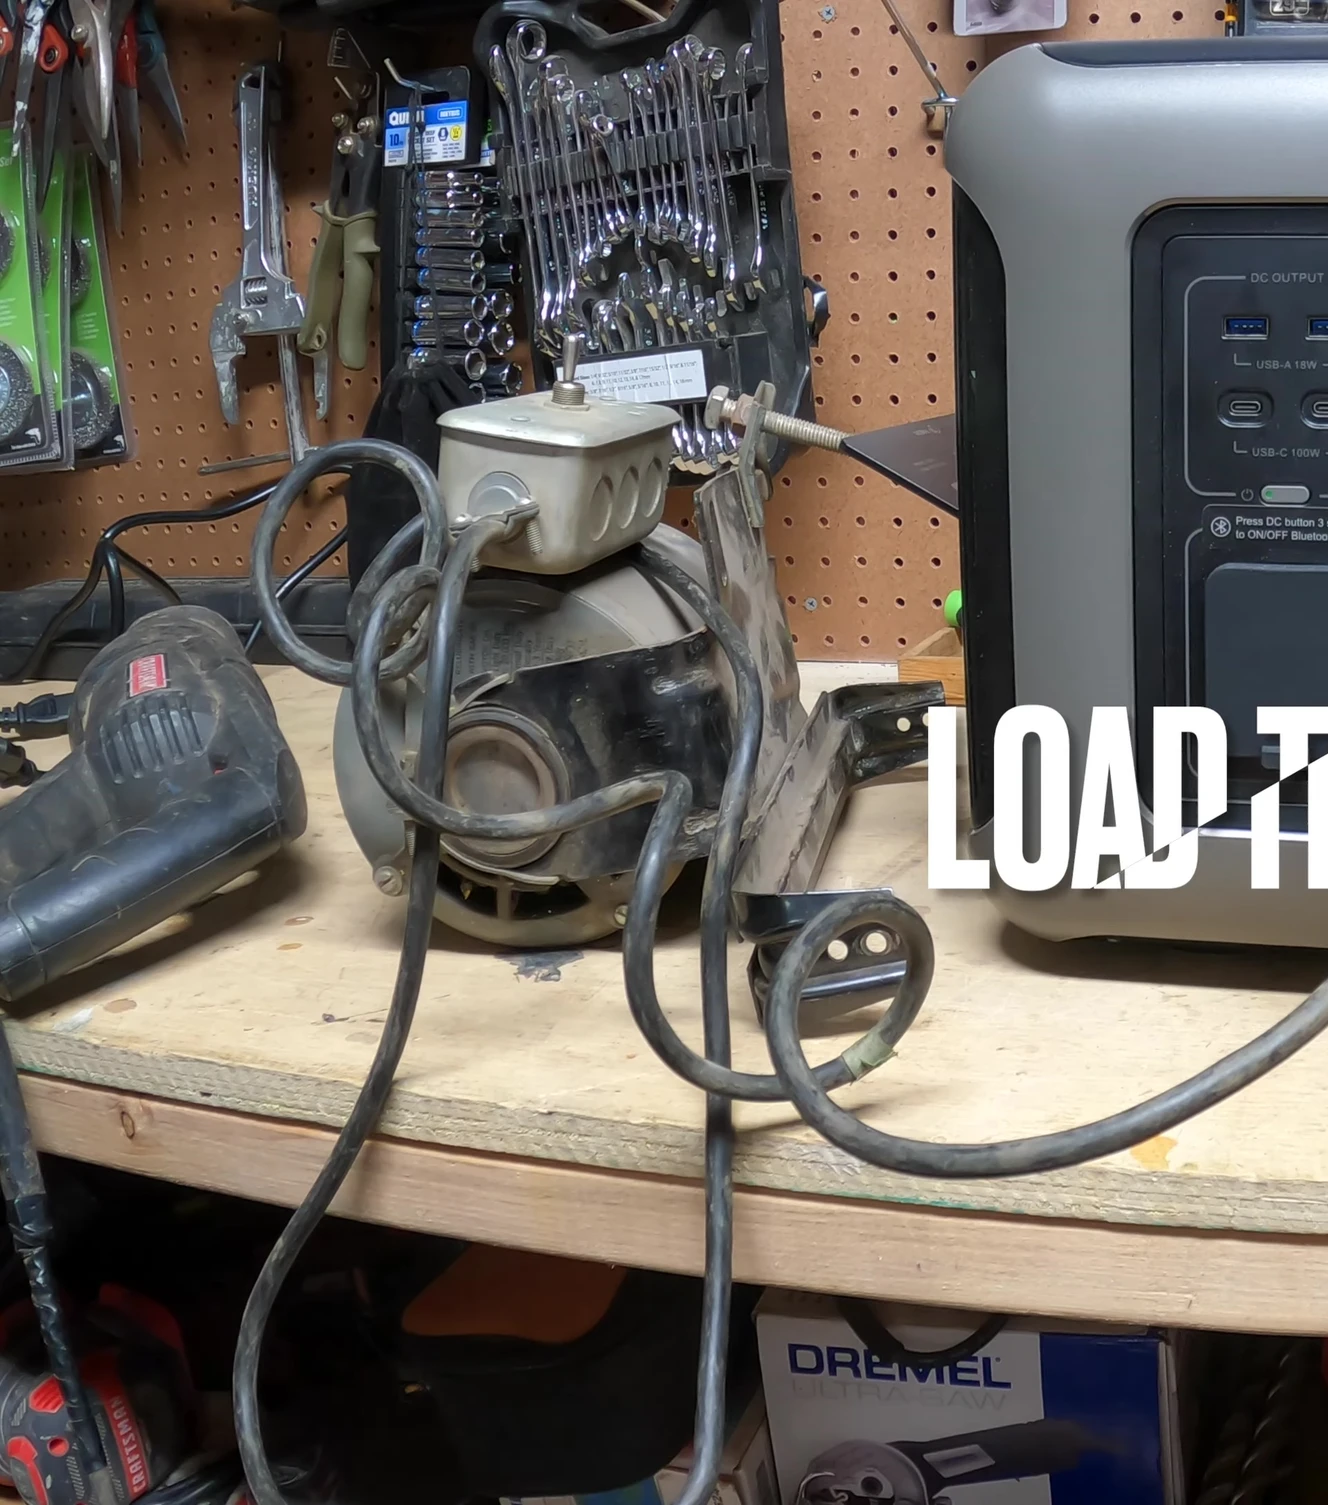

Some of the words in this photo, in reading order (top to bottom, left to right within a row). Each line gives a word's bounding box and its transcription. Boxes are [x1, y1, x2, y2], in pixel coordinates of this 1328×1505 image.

[1250, 272, 1269, 283] DC
[1272, 272, 1324, 283] OUTPUT
[1256, 360, 1292, 370] USB-A
[1295, 360, 1317, 370] 18W
[1252, 448, 1288, 457] USB-C
[1292, 449, 1320, 458] 100W
[1235, 516, 1263, 526] Press
[1266, 517, 1282, 527] DC
[1284, 518, 1315, 528] button
[1317, 518, 1324, 528] 3
[1235, 531, 1245, 540] to
[1247, 530, 1288, 541] ON/OFF
[788, 1343, 1012, 1389] DREMEL
[792, 1379, 913, 1402] ULTRA
[918, 1387, 1007, 1411] SAW
[110, 1396, 146, 1493] CRAFTSMAN
